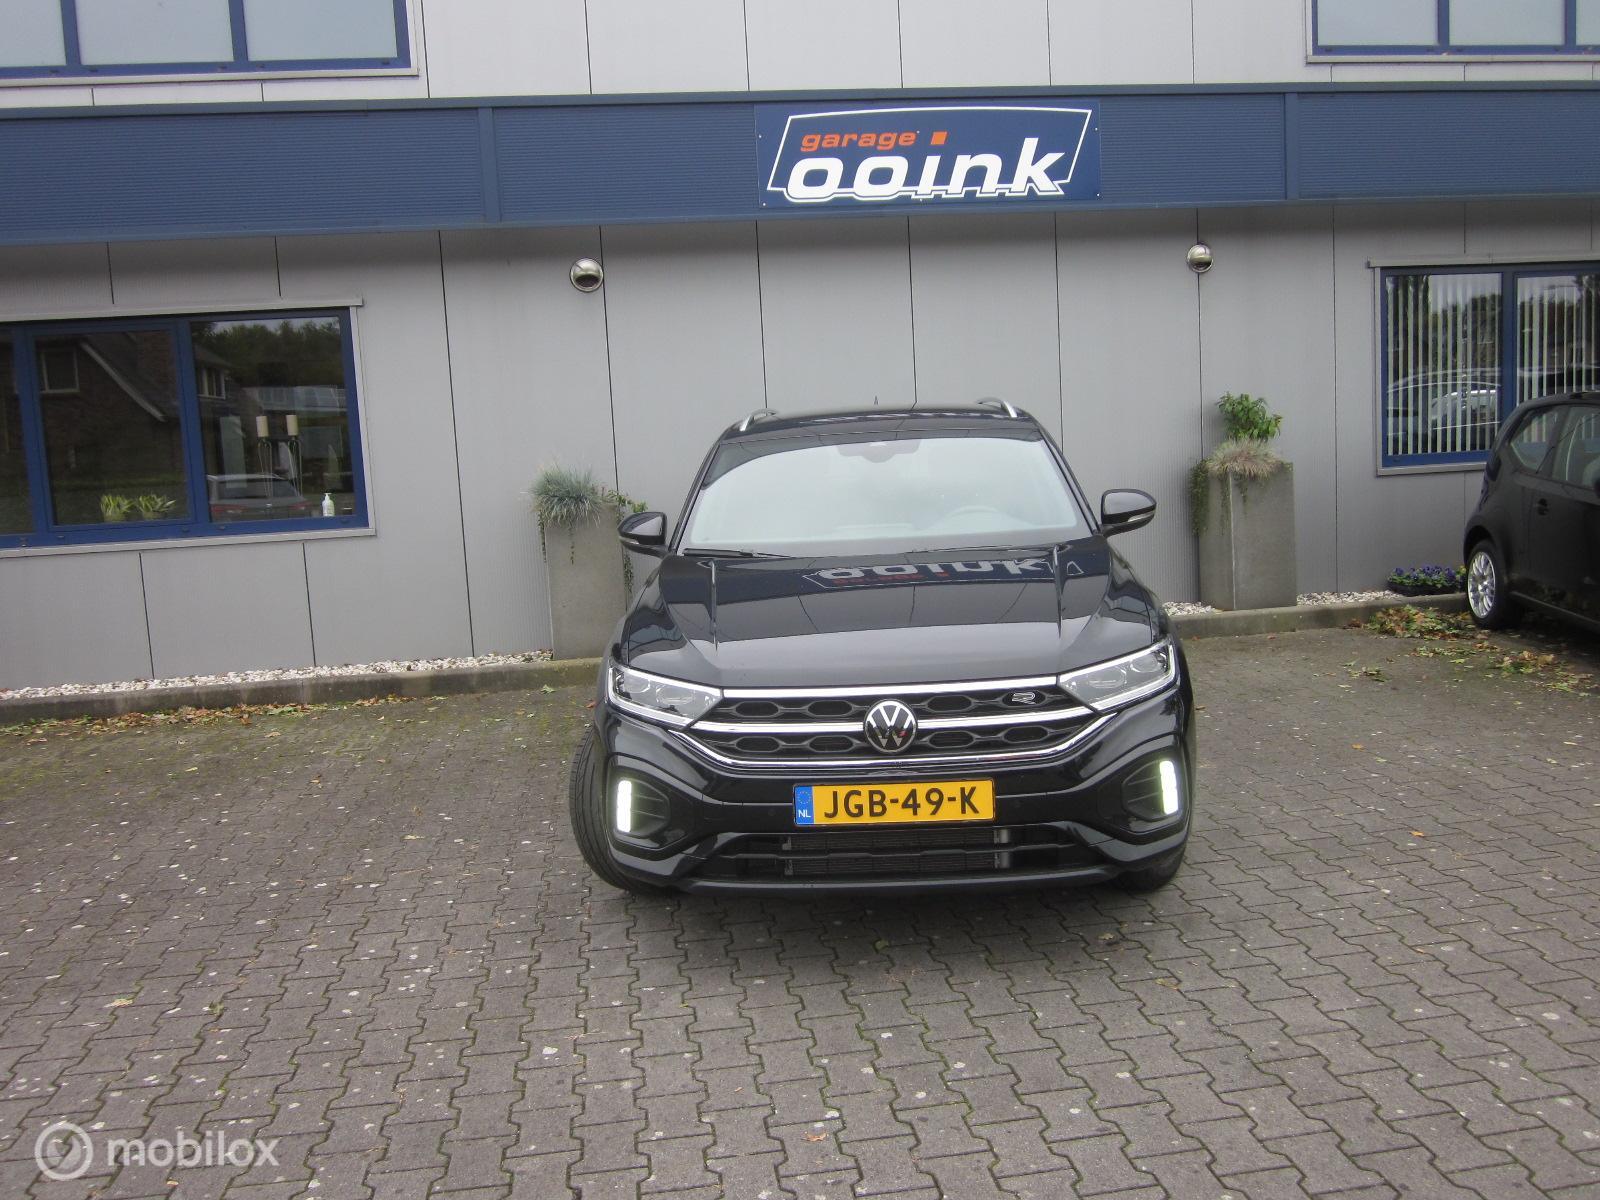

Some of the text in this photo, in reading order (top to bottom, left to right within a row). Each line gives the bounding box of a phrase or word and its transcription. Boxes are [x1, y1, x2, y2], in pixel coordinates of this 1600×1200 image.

[801, 131, 919, 152] garage
[786, 137, 1067, 200] ooink
[798, 786, 980, 819] NL JGB-49-K
